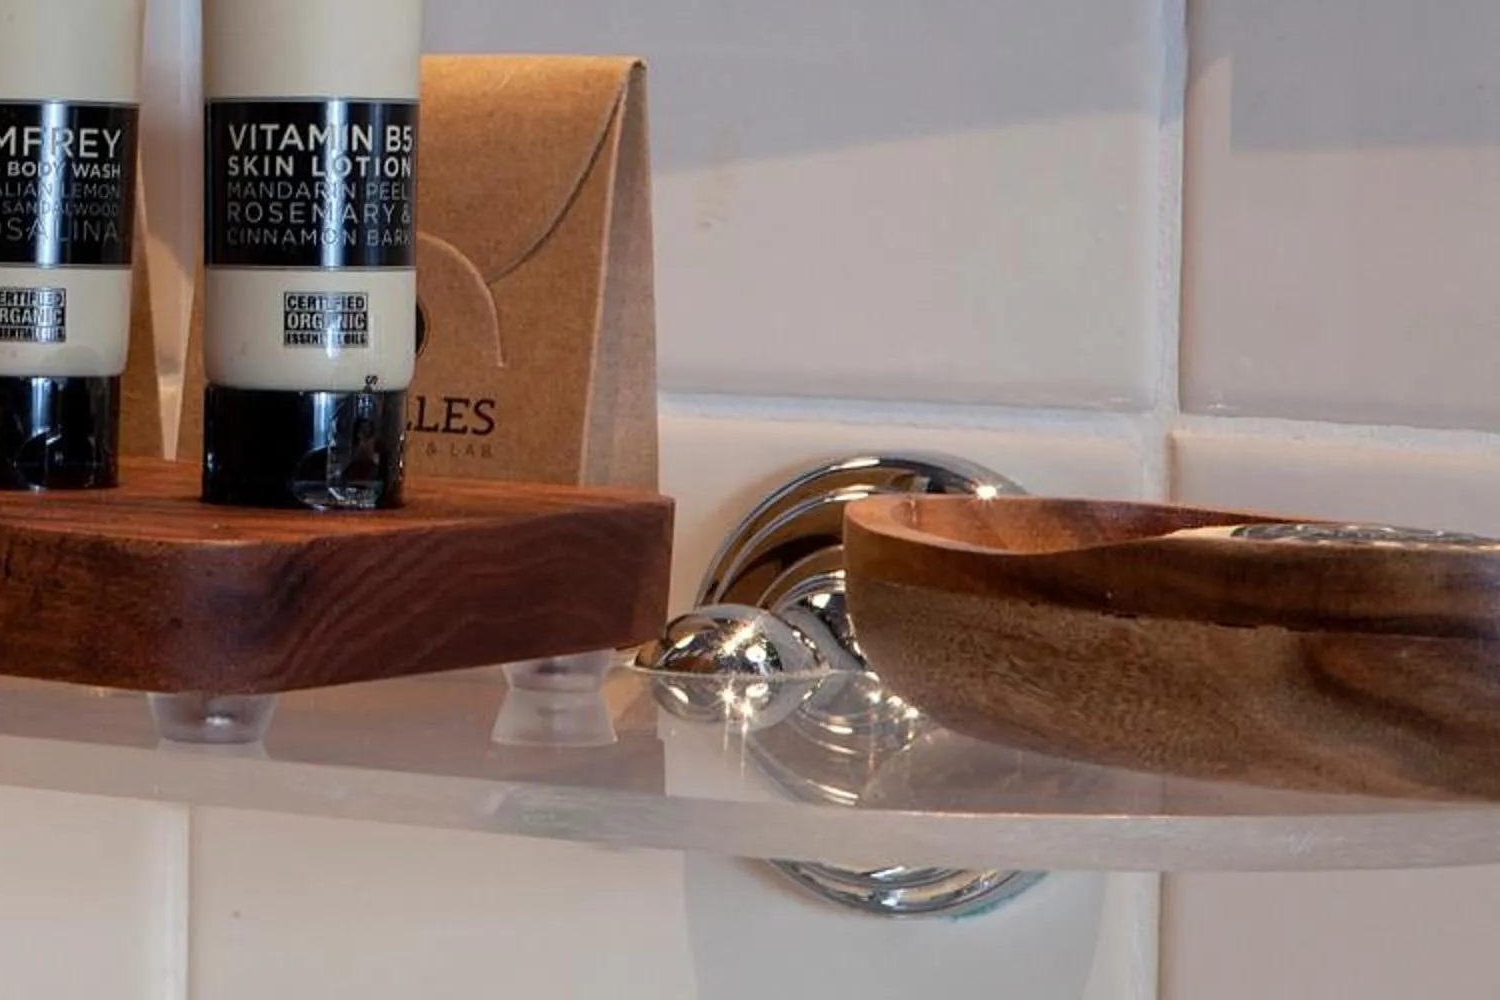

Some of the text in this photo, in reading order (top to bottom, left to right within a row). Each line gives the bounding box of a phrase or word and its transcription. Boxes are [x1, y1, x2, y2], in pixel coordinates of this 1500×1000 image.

[228, 123, 413, 152] VITAMIN B5
[7, 161, 65, 178] BODY
[72, 163, 121, 179] WASH
[228, 155, 411, 178] SKIN LOTION
[63, 182, 120, 199] LEMON
[228, 181, 409, 200] MANDARIN PEEL
[228, 202, 395, 224] ROSEMARY
[227, 227, 357, 246] CINNAMON
[287, 295, 365, 310] CERTIFIED
[287, 312, 365, 329] ORGANIC
